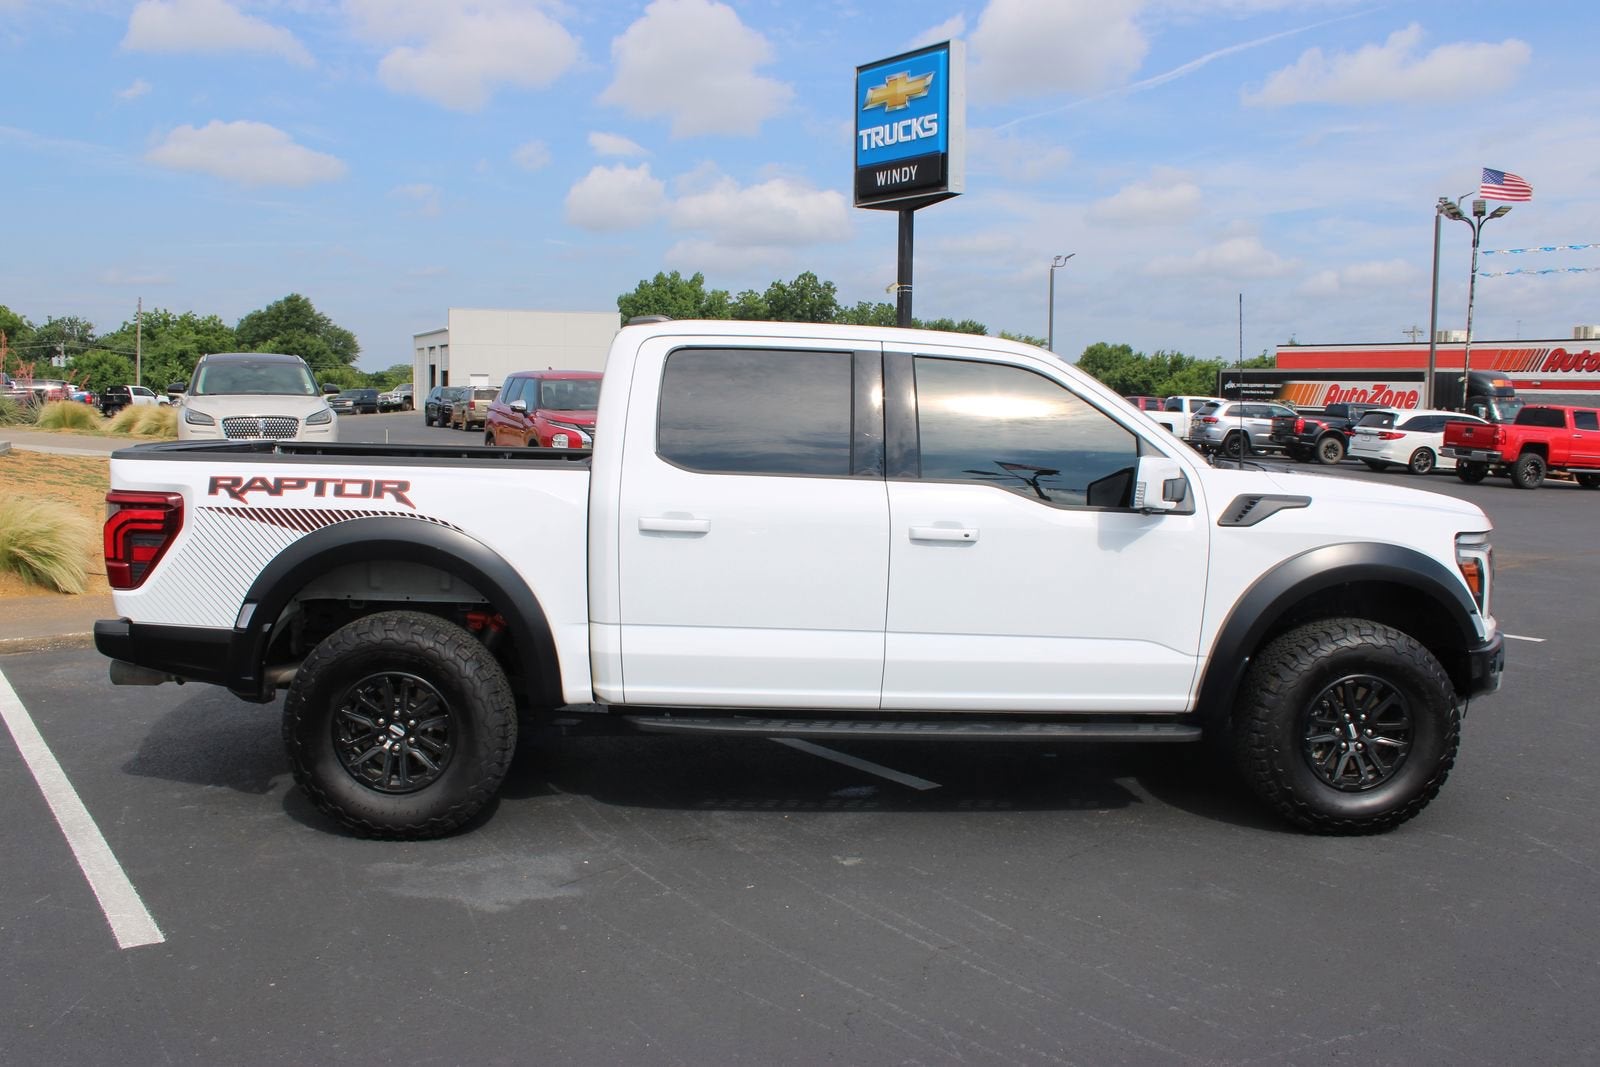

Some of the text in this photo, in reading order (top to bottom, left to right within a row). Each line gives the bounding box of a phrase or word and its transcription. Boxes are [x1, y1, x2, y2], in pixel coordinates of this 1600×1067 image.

[859, 113, 938, 151] TRUCKS
[876, 165, 918, 187] WINDY
[1541, 347, 1600, 372] Auto
[1322, 384, 1419, 410] AutoZone
[208, 476, 416, 510] RAPTOR
